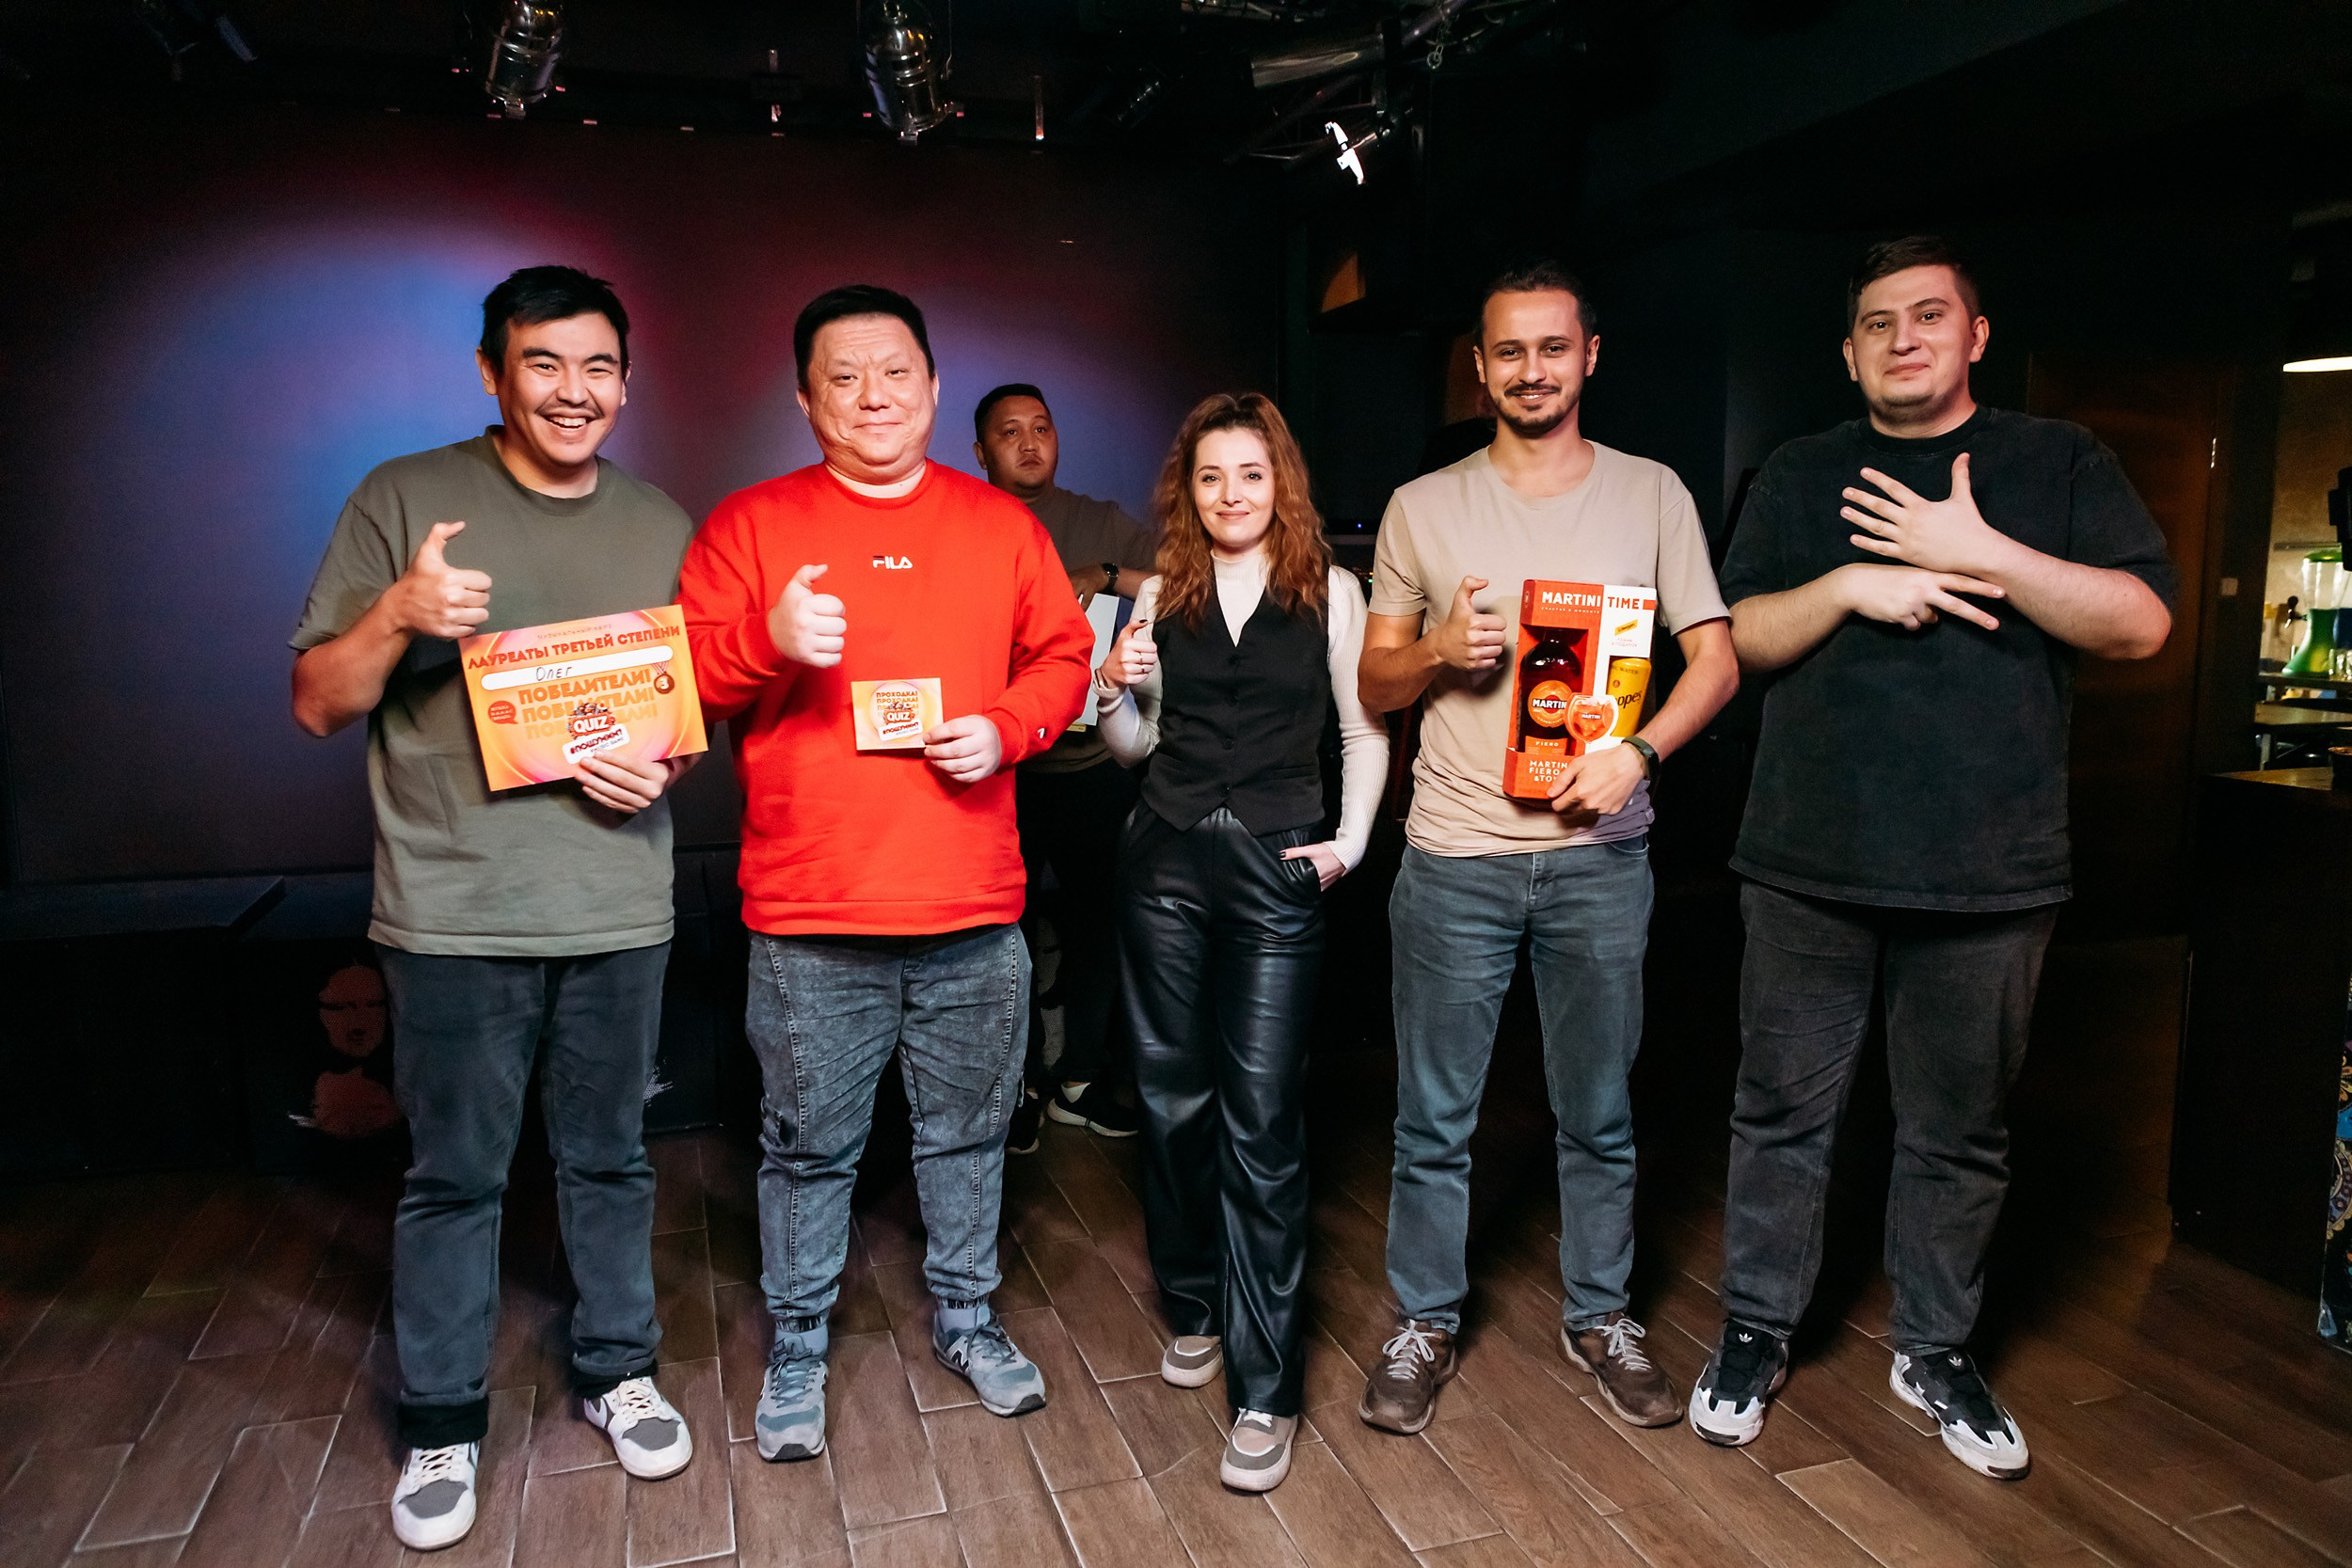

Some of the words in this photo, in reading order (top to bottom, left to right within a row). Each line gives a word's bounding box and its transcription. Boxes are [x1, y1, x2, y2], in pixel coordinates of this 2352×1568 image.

[872, 556, 913, 569] FILA
[1542, 592, 1601, 608] MARTINI
[1607, 596, 1640, 610] TIME
[468, 646, 548, 669] ЛАУРЕАТЫ
[551, 633, 614, 656] ТРЕТЬЕЙ
[617, 625, 680, 645] СТЕПЕНИ
[518, 669, 652, 705] ПОБЕДИТЕЛИ!
[886, 712, 911, 721] QUIZ
[574, 715, 610, 734] QUIZ
[1530, 760, 1568, 768] MARTIN
[1529, 768, 1560, 776] FIERO
